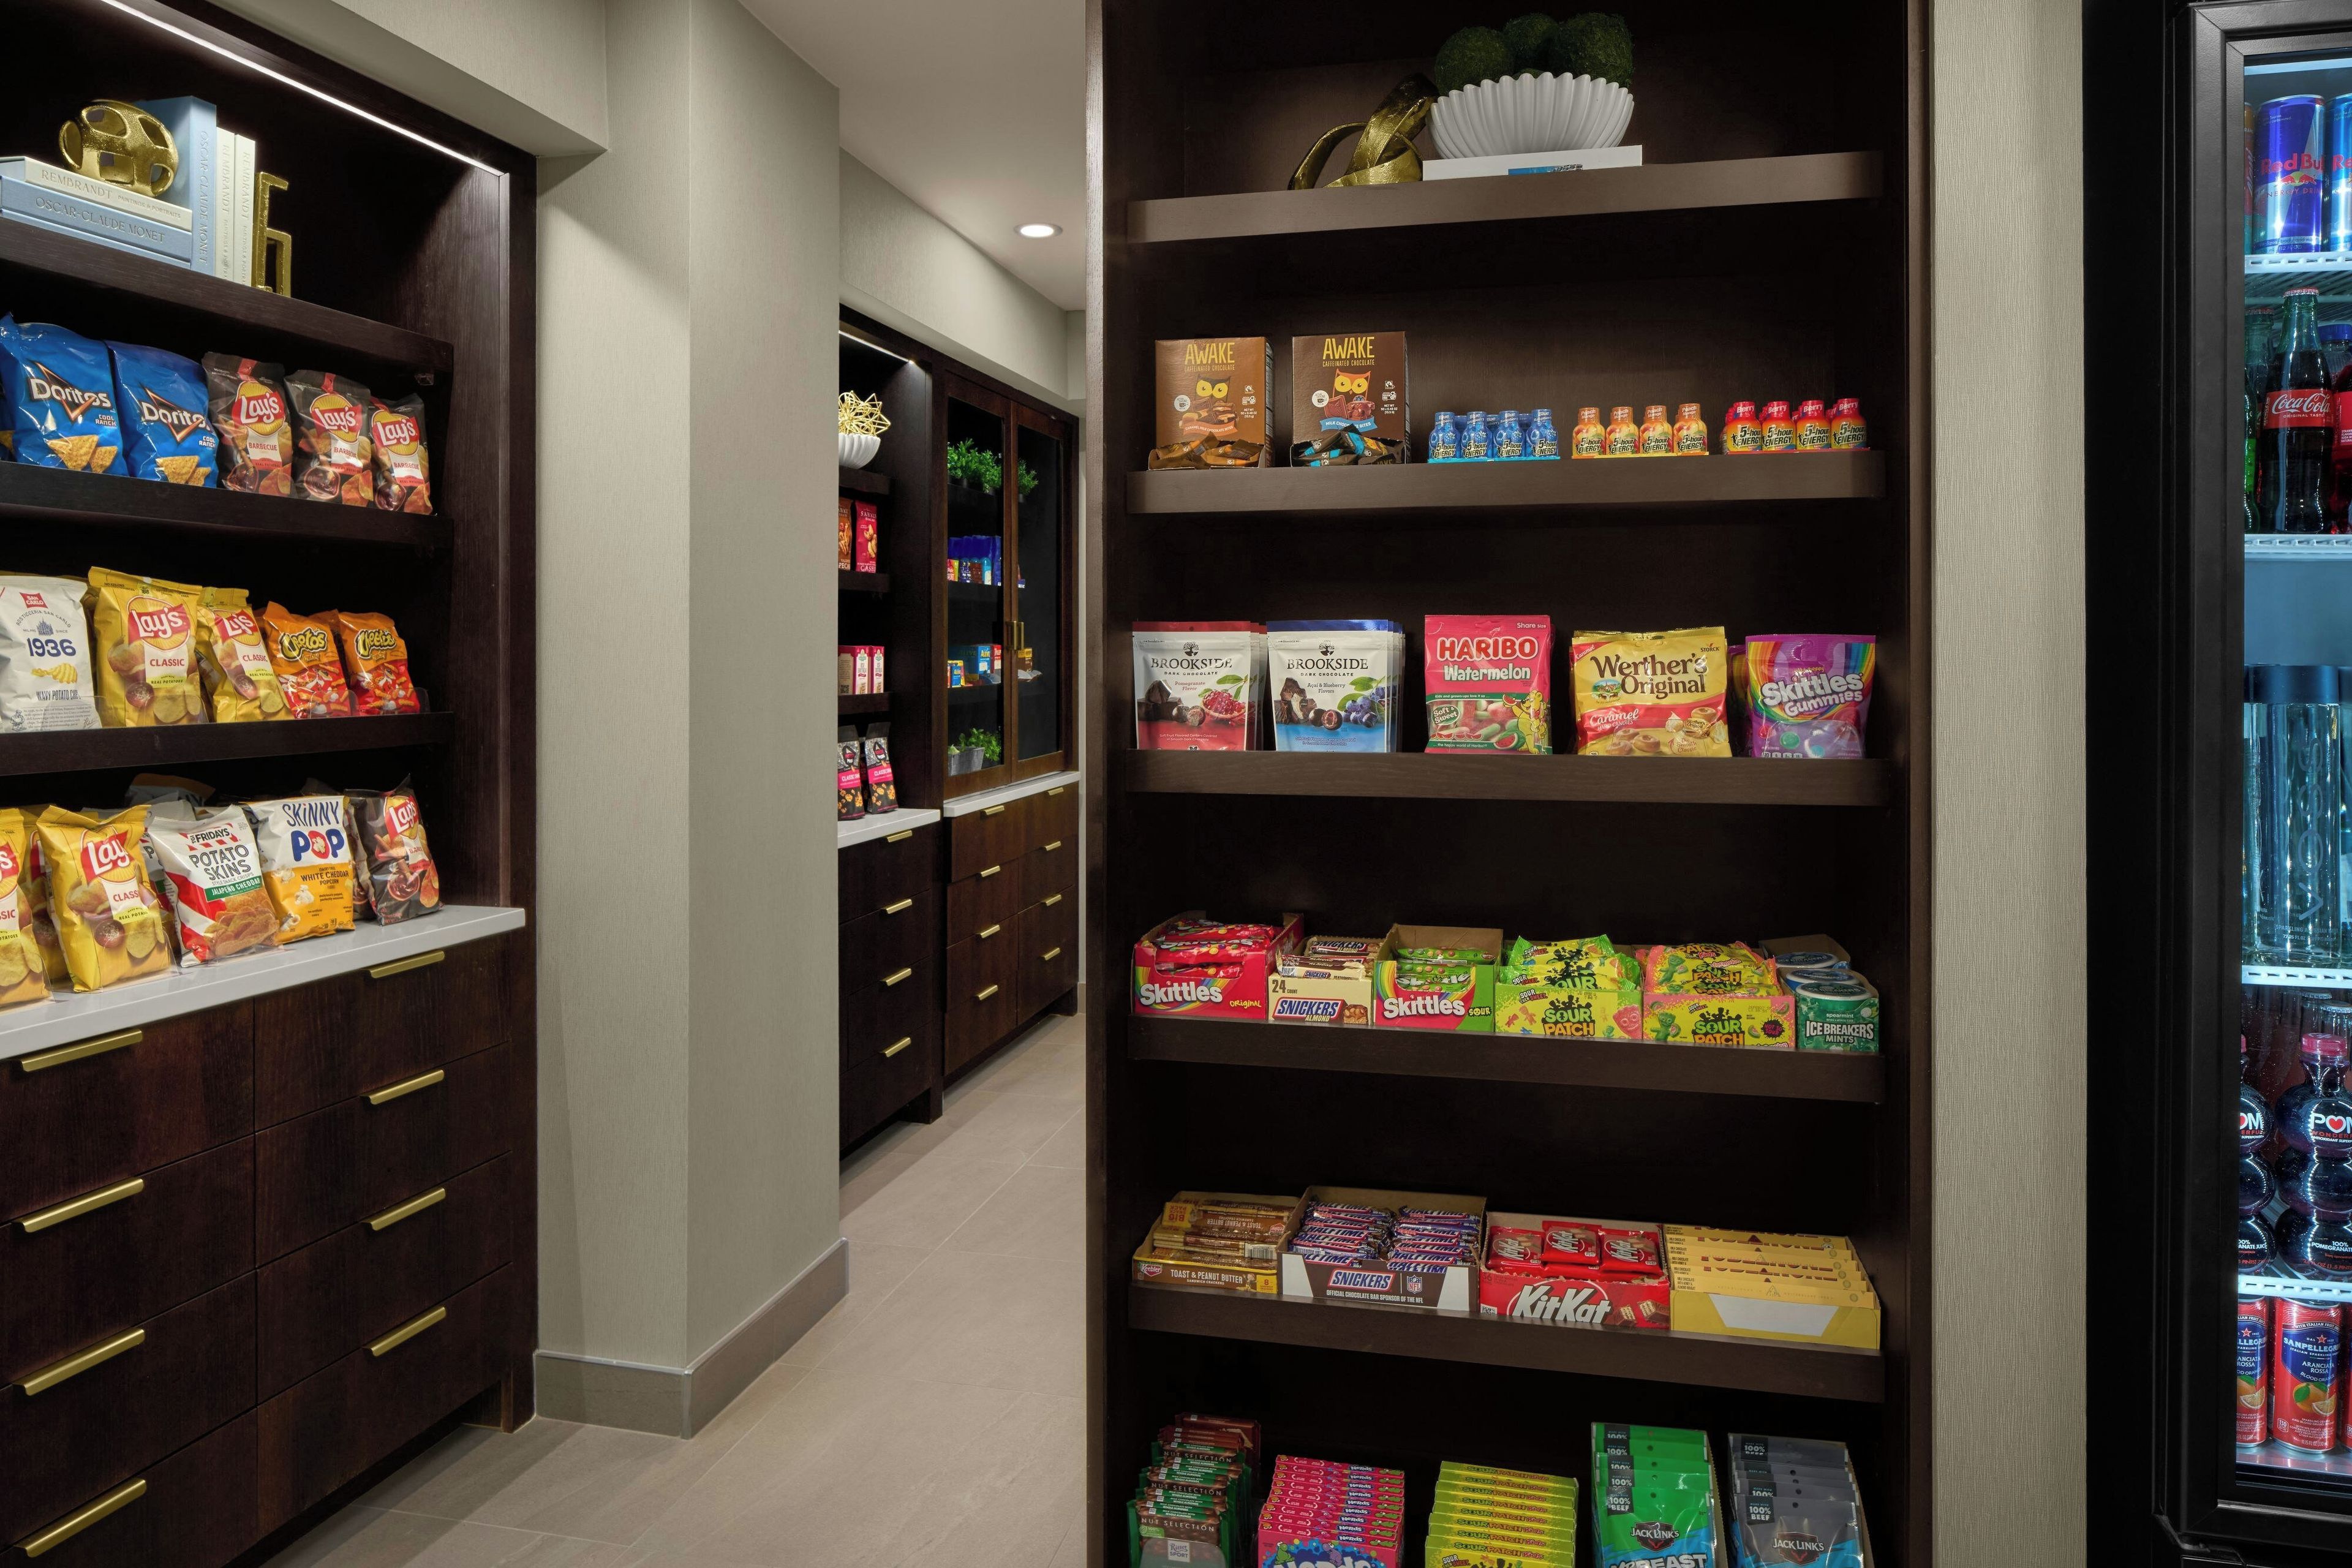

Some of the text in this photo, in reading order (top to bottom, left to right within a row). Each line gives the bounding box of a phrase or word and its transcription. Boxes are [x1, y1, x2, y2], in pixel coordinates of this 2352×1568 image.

[2261, 153, 2297, 175] Red
[42, 170, 113, 199] REMBRANDT
[118, 195, 146, 208] PAINTINGS
[152, 206, 181, 219] PORTRAITS
[35, 197, 165, 243] OSCAR-CLAUDE MONET
[1185, 342, 1235, 364] AWAKE
[1322, 336, 1374, 360] AWAKE
[29, 378, 111, 408] Doritos
[240, 393, 281, 424] Lay's
[2272, 392, 2331, 415] Coca-Cola
[314, 407, 358, 432] Lay's
[376, 419, 417, 446] Lay's
[249, 442, 277, 451] BARBECUE
[334, 447, 357, 458] BARBECUE
[1434, 449, 1455, 458] ENERGY
[1436, 442, 1455, 450] 5-hour
[1465, 448, 1485, 458] ENERGY
[393, 461, 420, 470] BARBECUE
[16, 610, 42, 626] ROSTICCERIA
[132, 607, 183, 638] Lay's
[27, 638, 77, 657] 1936
[1437, 637, 1538, 661] HARIBO
[1151, 658, 1232, 669] BROOKSIDE
[1287, 659, 1368, 670] BROOKSIDE
[1443, 664, 1530, 680] Watermelon
[1591, 652, 1707, 678] Werther's
[1620, 674, 1706, 699] Original
[1762, 673, 1864, 706] Skittles
[1784, 690, 1863, 717] Gummies
[1435, 711, 1458, 723] Sweet
[1589, 709, 1639, 726] Caramel
[389, 800, 416, 834] Lay's
[195, 828, 230, 843] FRIDAYS
[2297, 737, 2324, 920] VOSS
[290, 829, 345, 862] POP
[190, 845, 249, 870] POTATO
[205, 860, 252, 881] SKINS
[301, 870, 349, 882] WHITE CHEDDAR
[211, 878, 261, 897] JALAPEÑO CHEDDAR
[1140, 981, 1223, 1005] Skittles
[1272, 979, 1286, 993] 24
[1277, 1000, 1338, 1016] SNICKERS
[1383, 994, 1465, 1018] Skittles
[1468, 1007, 1491, 1017] SOUR
[1543, 1022, 1594, 1036] PATCH
[1807, 1021, 1874, 1038] ICE BREAKERS
[1826, 1035, 1854, 1044] MINTS
[1140, 1264, 1161, 1274] Keebler
[1171, 1269, 1189, 1278] TOAST
[1198, 1272, 1219, 1281] PEANUT
[1221, 1274, 1242, 1284] BUTTER
[1332, 1271, 1392, 1289] SNICKERS
[1409, 1283, 1421, 1292] NFL
[1512, 1285, 1611, 1324] KitKat
[2301, 1371, 2318, 1381] BLOOD
[1173, 1485, 1222, 1496] SELECTION
[1164, 1521, 1214, 1531] SELECTION
[1631, 1528, 1651, 1538] JACK
[1773, 1539, 1824, 1551] JACK LINK'S
